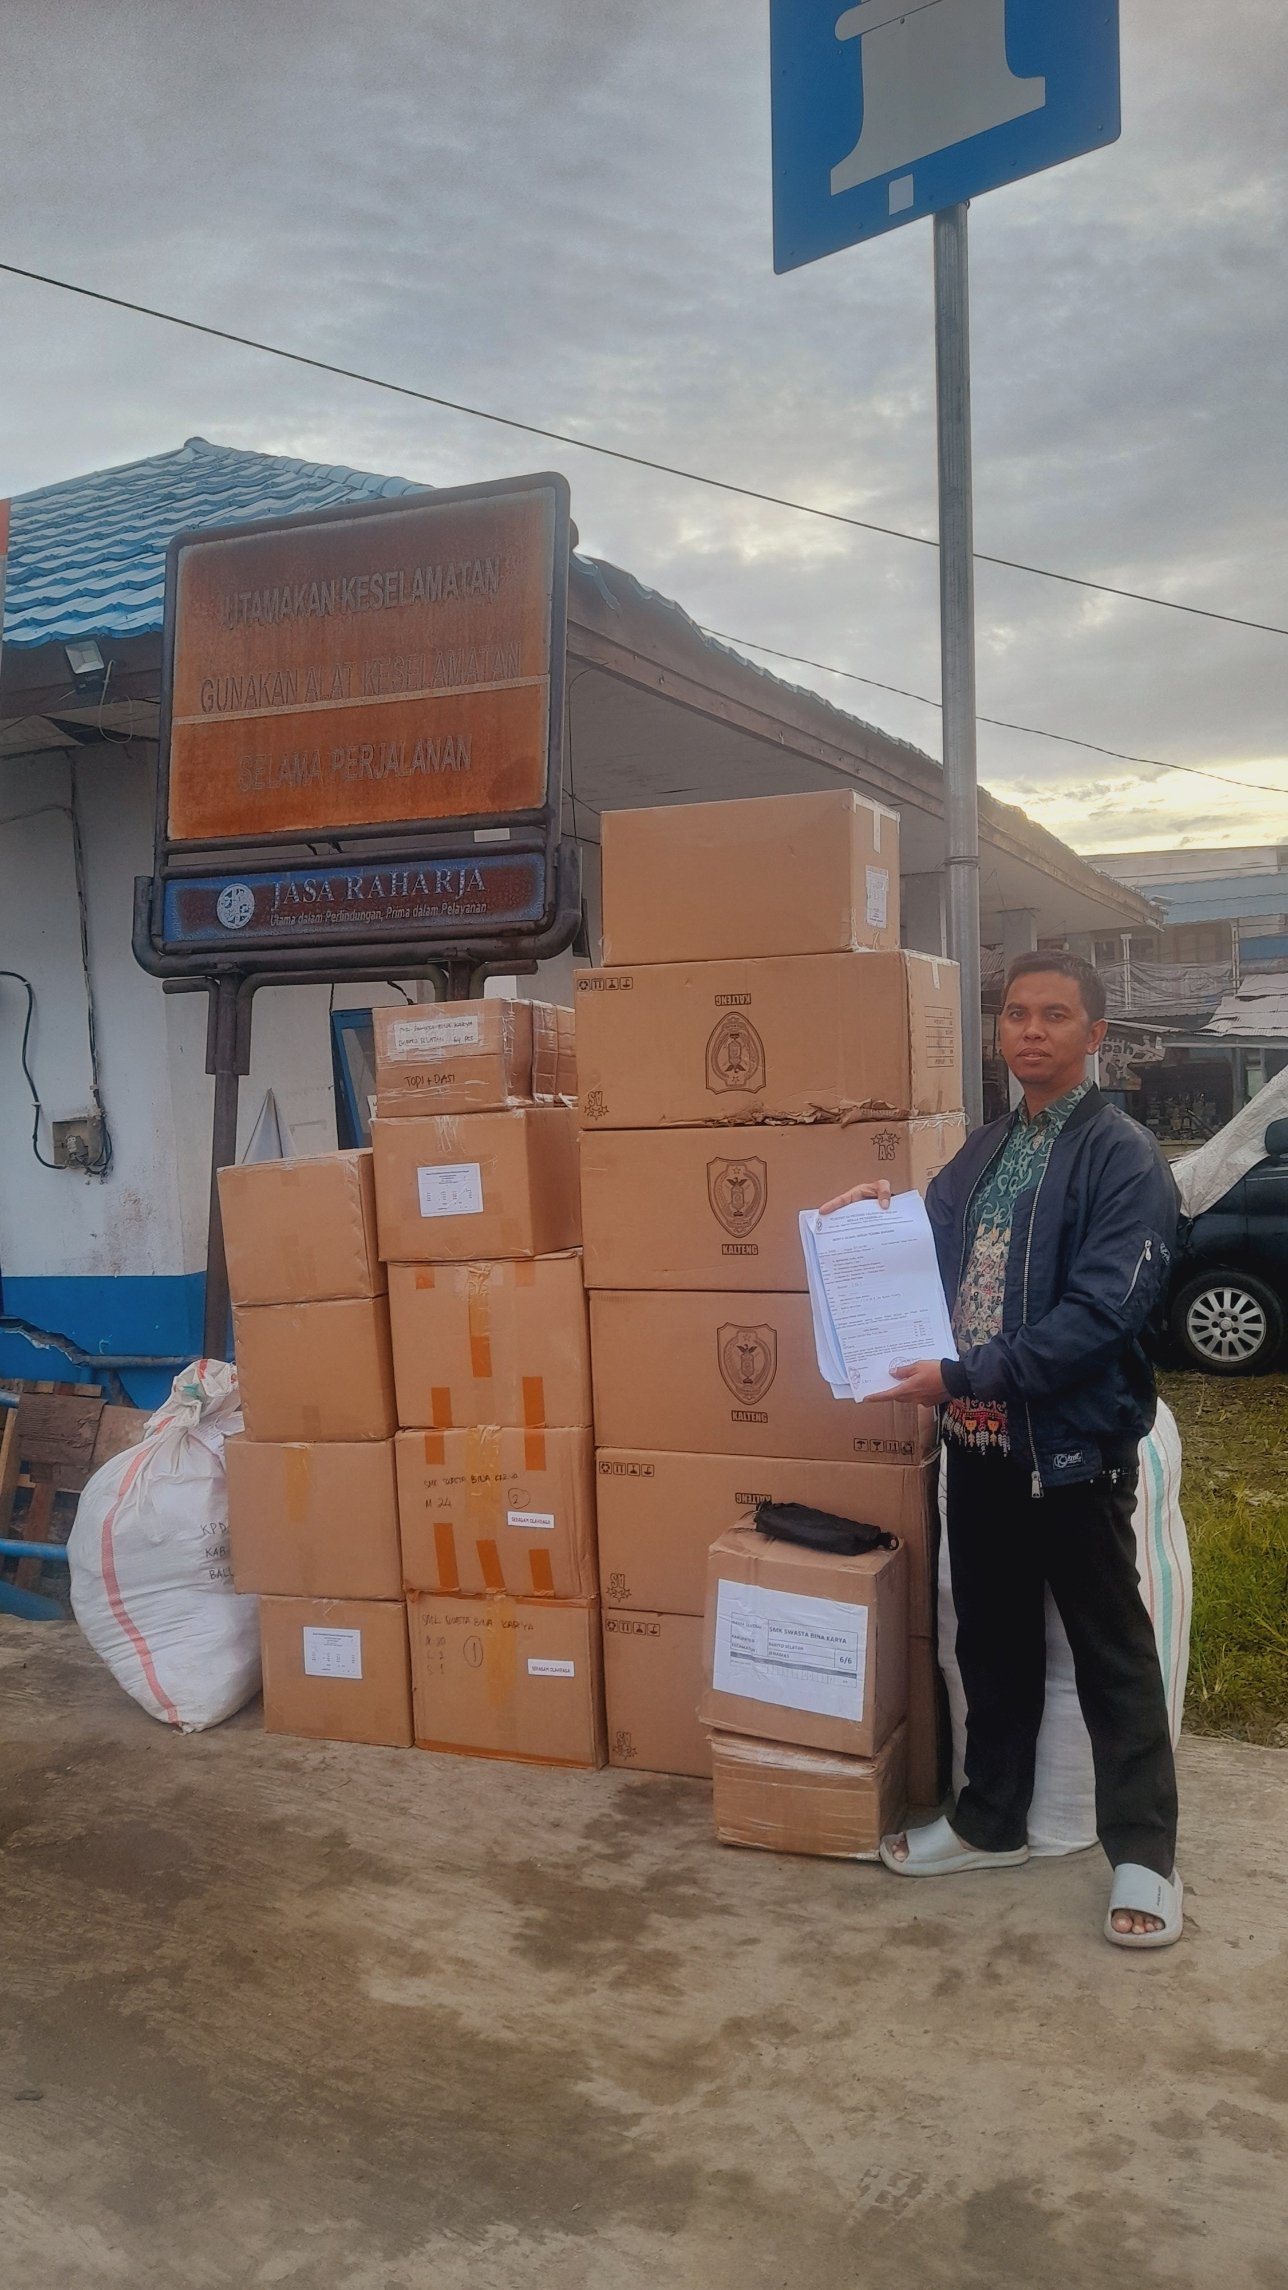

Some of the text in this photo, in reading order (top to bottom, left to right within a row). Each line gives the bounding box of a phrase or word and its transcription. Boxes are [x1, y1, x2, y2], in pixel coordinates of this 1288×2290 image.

[222, 556, 500, 630] UTAMAKAN KESELAMATAN
[200, 641, 522, 713] GUNAKAN ALAT KESELAMATAN
[238, 734, 473, 792] SELAMA PERJALANAN
[270, 868, 488, 911] JASA RAHARJA
[270, 914, 296, 927] Utama
[298, 912, 324, 925] dalam
[386, 905, 410, 919] Prima
[412, 902, 440, 917] dalam
[441, 901, 488, 918] Pelayanan
[715, 993, 751, 1006] KALTENG
[404, 1075, 425, 1087] TOPI
[433, 1073, 456, 1084] DASI
[877, 1145, 896, 1161] AS
[721, 1243, 759, 1255] KALTENG
[731, 1410, 769, 1424] KALTENG
[205, 1546, 226, 1557] KAB
[769, 1626, 848, 1644] SMK SWASTA BINA KARYA
[839, 1656, 853, 1665] 6/6
